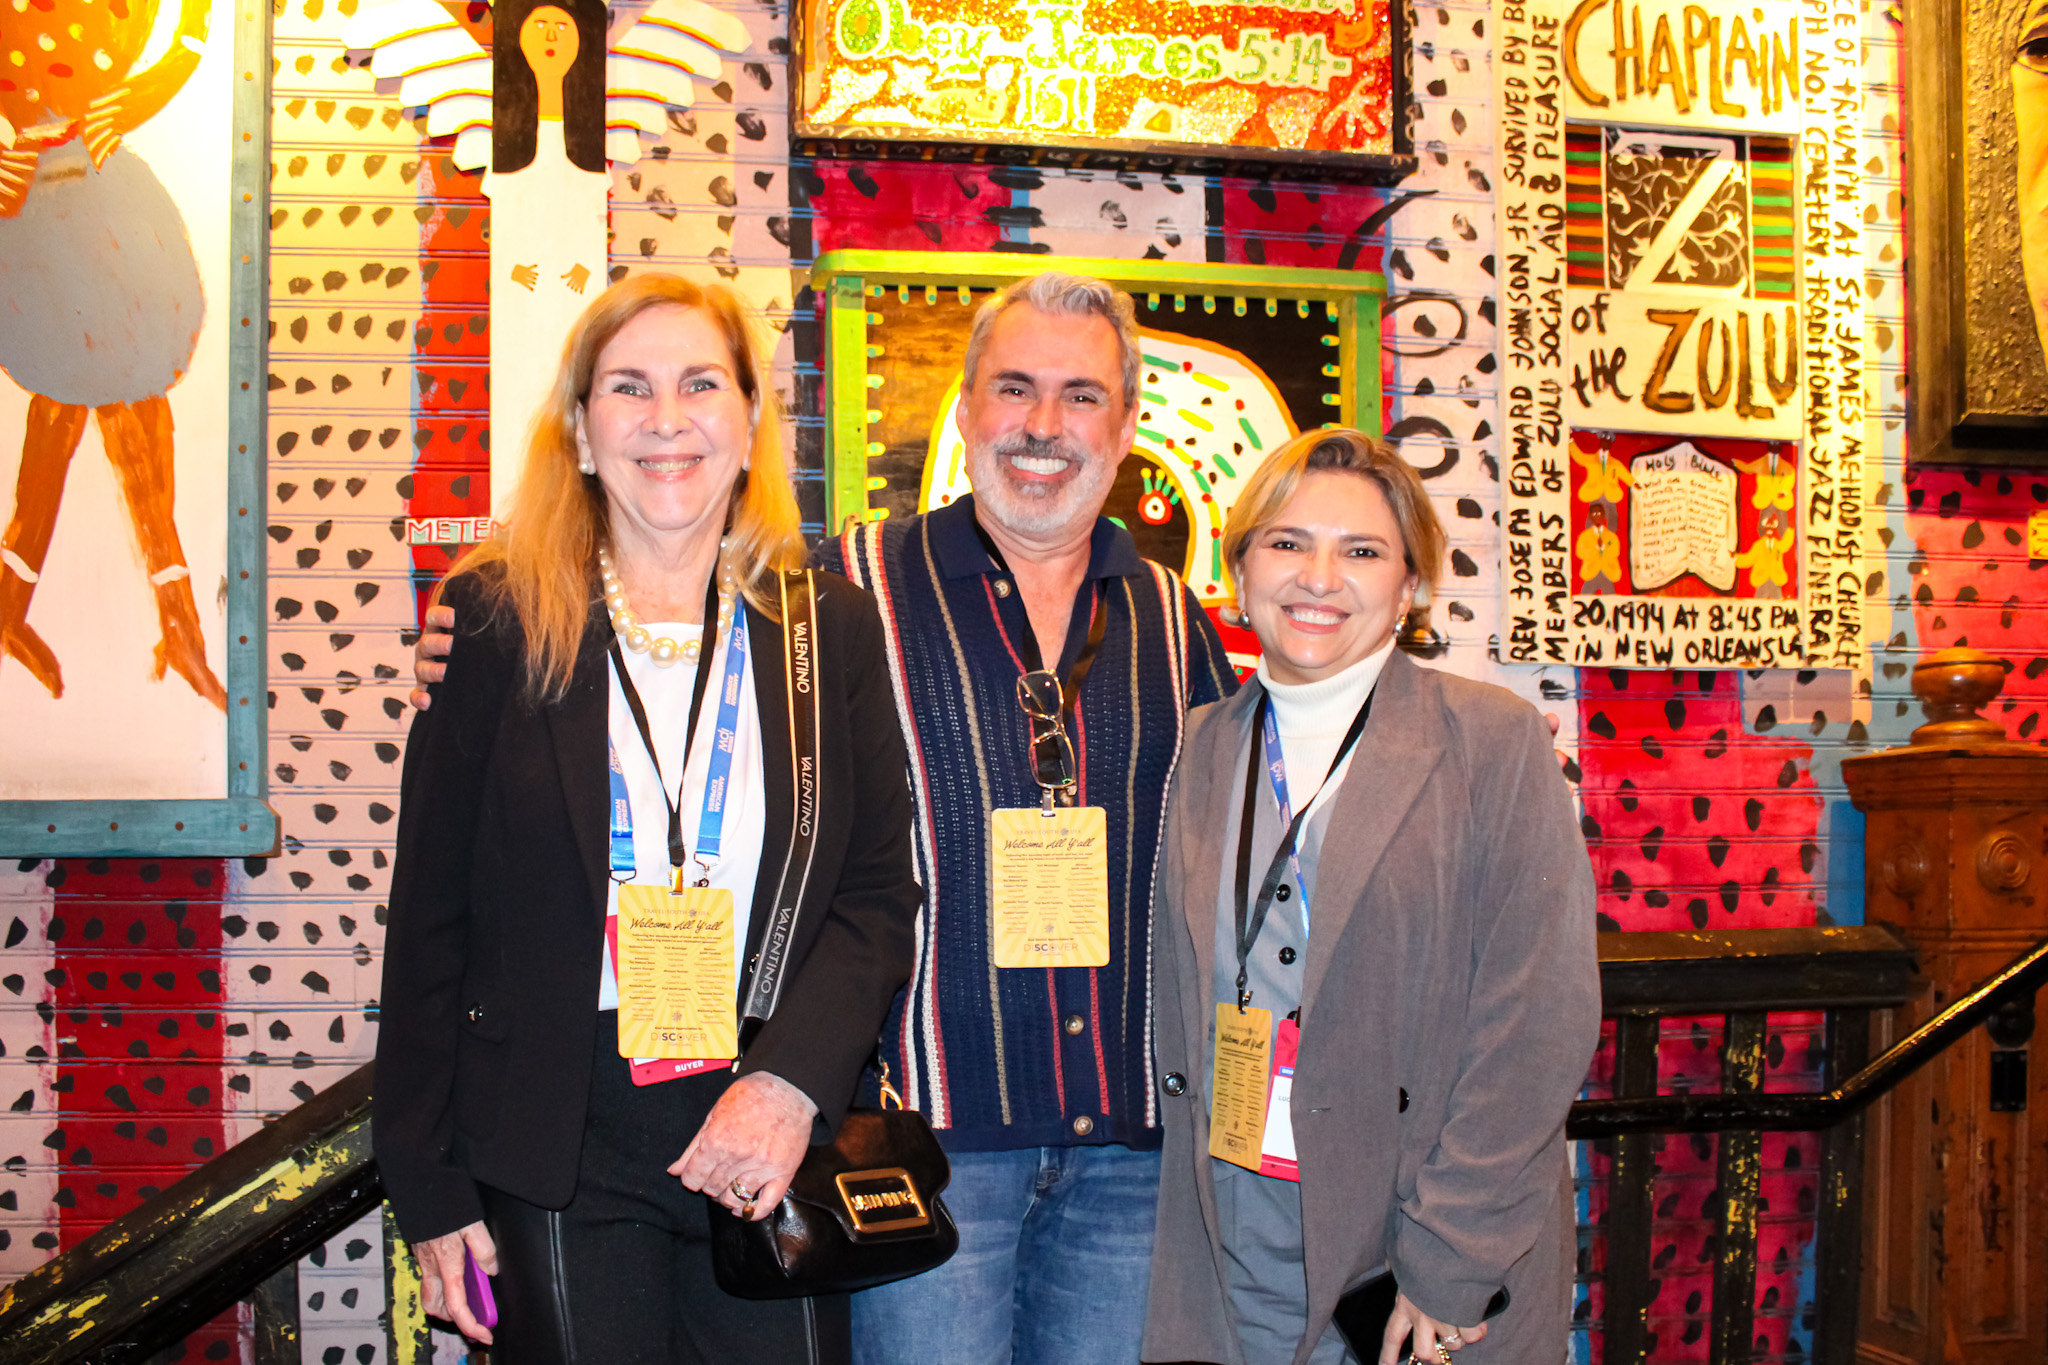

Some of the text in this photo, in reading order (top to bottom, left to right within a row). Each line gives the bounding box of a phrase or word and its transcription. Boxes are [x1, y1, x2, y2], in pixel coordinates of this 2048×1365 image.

[1025, 8, 1223, 80] James
[1502, 36, 1529, 65] BY
[1833, 38, 1857, 68] OF
[1023, 73, 1091, 130] 16!
[1532, 15, 1561, 160] PLEASURE
[1529, 173, 1562, 194] &
[1506, 202, 1529, 241] JR
[1641, 304, 1798, 421] ZULU
[1834, 322, 1863, 426] JAMES
[1537, 379, 1563, 447] ZULU
[1508, 386, 1538, 498] EDWARD
[1541, 458, 1566, 492] OF
[1808, 445, 1834, 527] JAZZ
[1508, 508, 1534, 600] JOSEPH
[1539, 511, 1569, 662] MEMBERS
[1509, 607, 1539, 662] REV.
[1708, 604, 1763, 632] 8:45
[1832, 571, 1862, 669] CHURCH
[792, 621, 811, 694] VALENTINO
[1614, 633, 1674, 665] NEW
[1685, 635, 1775, 665] ORLEANS
[707, 779, 718, 812] EXPRESS
[714, 775, 726, 813] AMERICAN
[800, 756, 813, 837] VALENTINO
[1003, 837, 1096, 851] Welcome All Y'all
[630, 917, 724, 934] Welcome All Y'all
[760, 907, 793, 994] VALENTINO
[1023, 943, 1079, 952] DISCOVER
[650, 1032, 707, 1042] DISCOVER
[674, 1060, 704, 1073] BUYER
